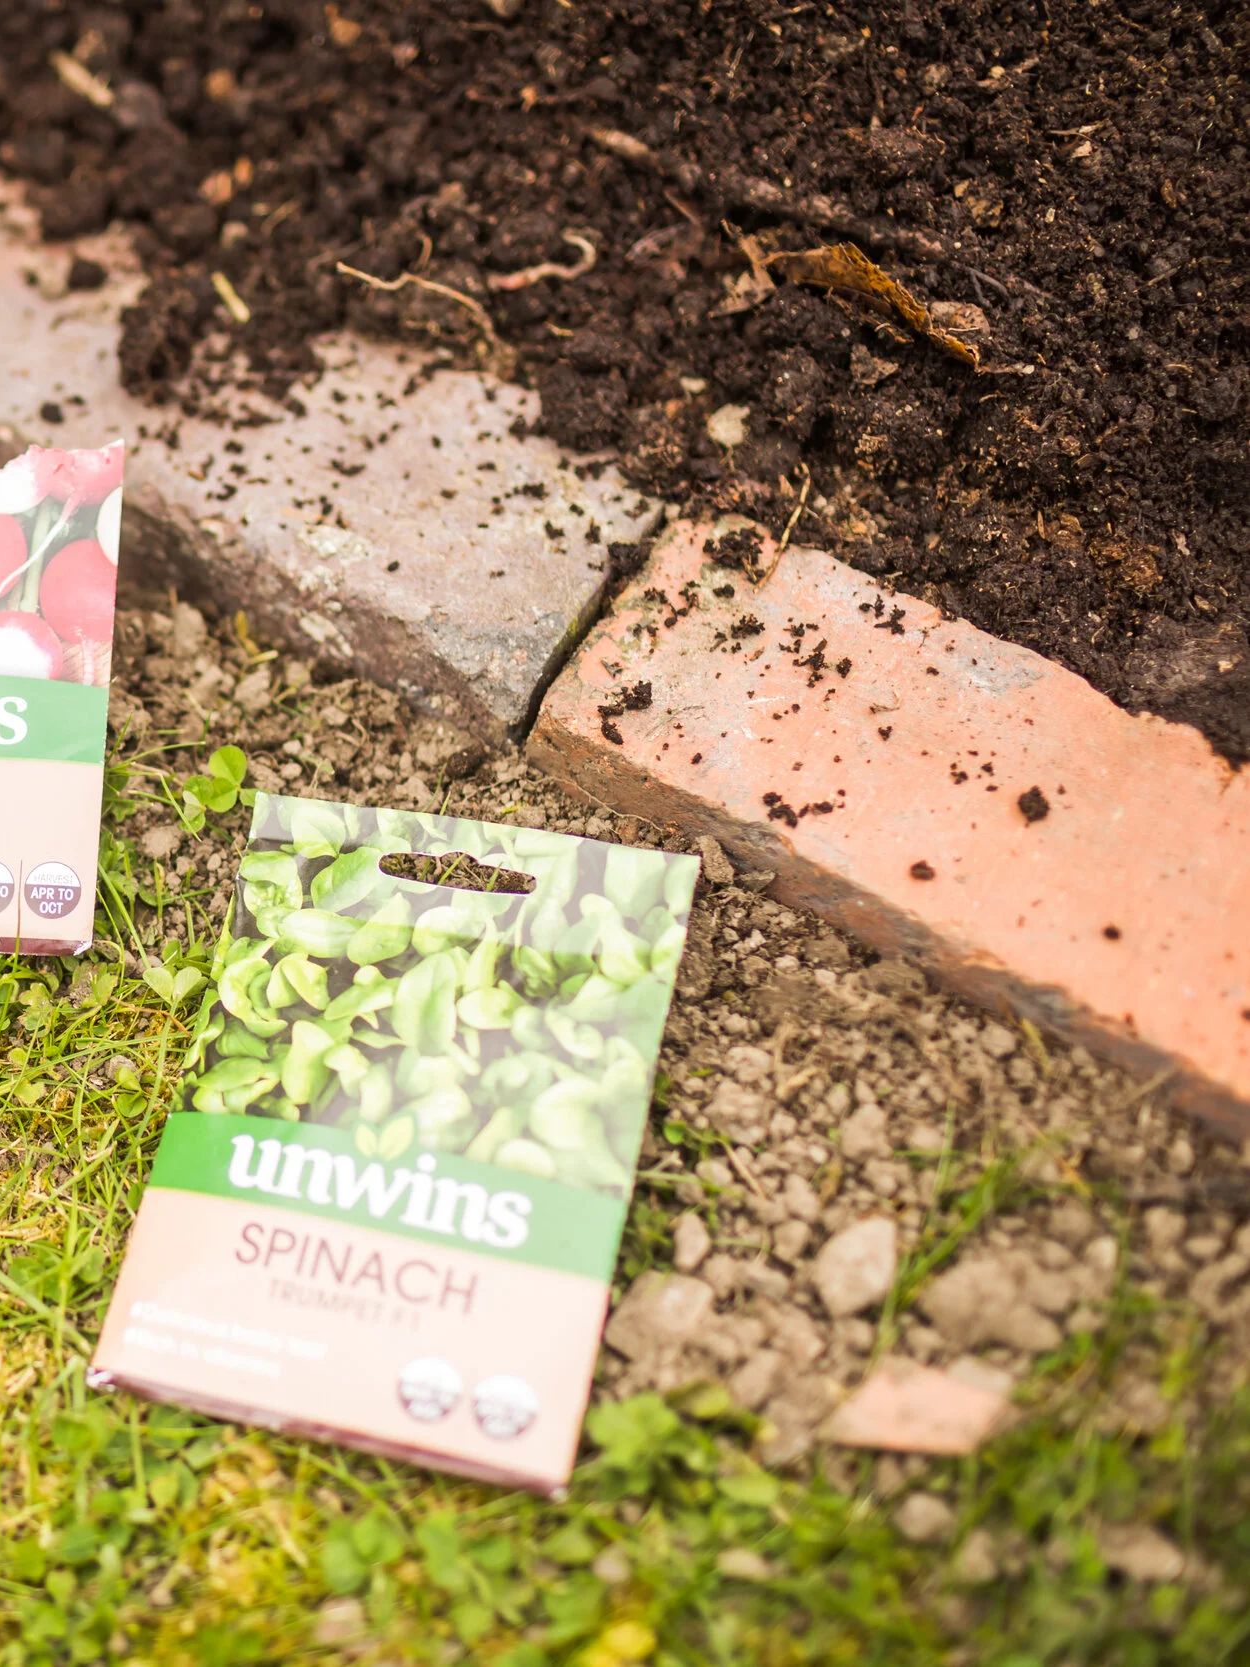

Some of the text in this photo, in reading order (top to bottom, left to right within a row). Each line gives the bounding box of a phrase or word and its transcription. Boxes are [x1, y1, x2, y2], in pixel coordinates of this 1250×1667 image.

[30, 887, 74, 901] APR TO
[39, 902, 64, 914] OCT
[228, 1133, 533, 1248] unwins
[234, 1221, 478, 1314] SPINACH
